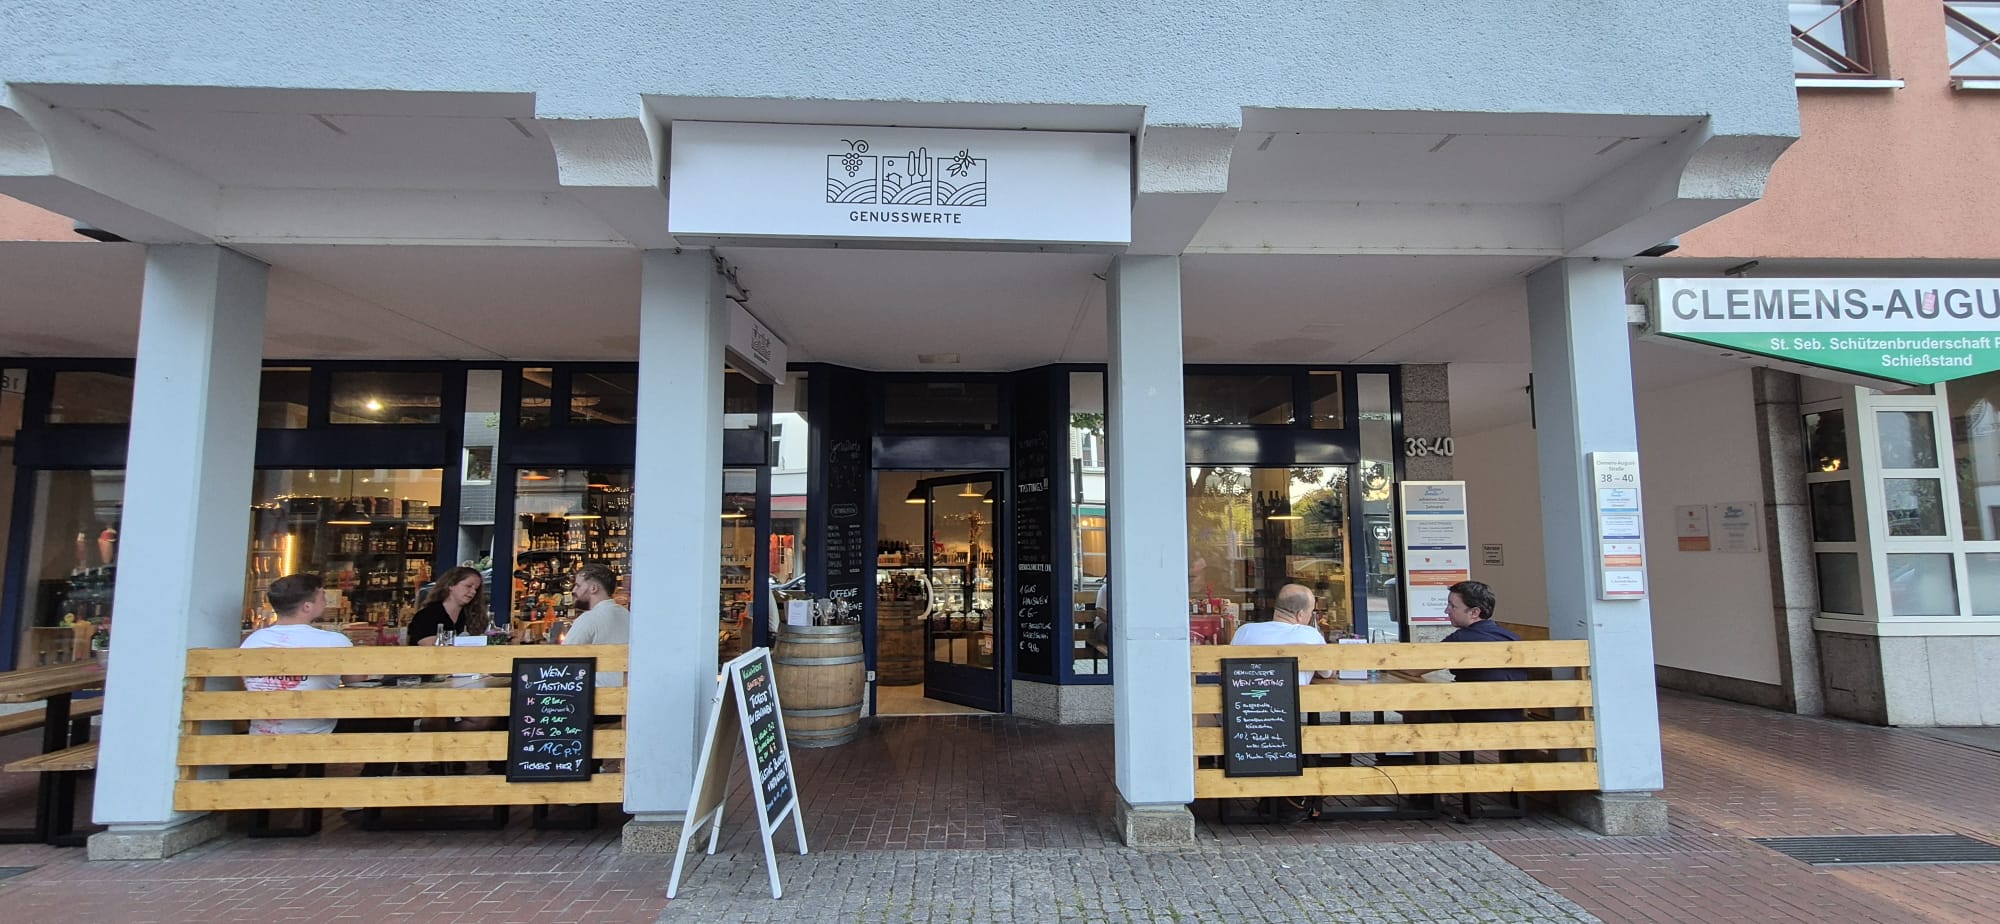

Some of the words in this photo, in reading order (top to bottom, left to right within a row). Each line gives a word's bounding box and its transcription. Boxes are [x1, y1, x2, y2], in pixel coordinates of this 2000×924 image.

[849, 211, 961, 224] GENUSSWERTE
[1671, 288, 2000, 321] CLEMENS-AUGU
[1770, 337, 1788, 350] St.
[1793, 337, 1825, 350] Seb.
[1829, 336, 1991, 351] Schützenbruderschaft
[1881, 354, 1973, 367] Schießstand
[1406, 437, 1454, 457] 38-40
[1601, 474, 1612, 483] 38
[1622, 474, 1634, 483] 40
[533, 680, 583, 692] TASTINGS
[1234, 701, 1241, 710] 5
[549, 727, 561, 737] 20
